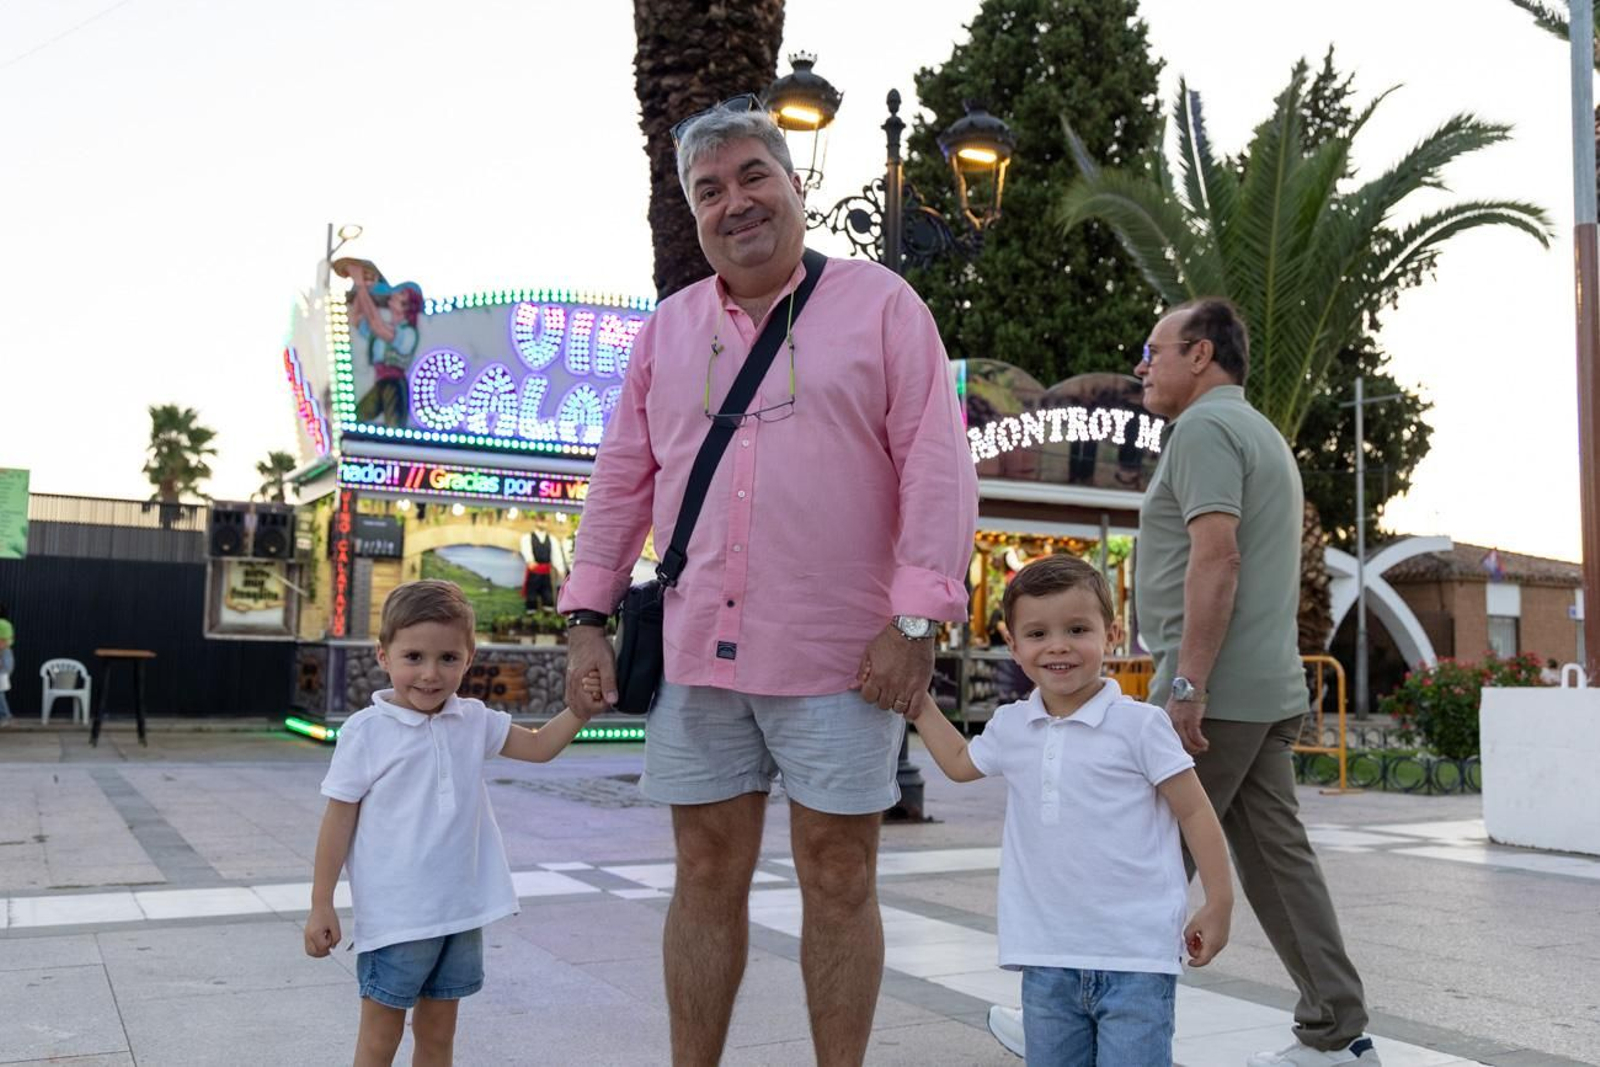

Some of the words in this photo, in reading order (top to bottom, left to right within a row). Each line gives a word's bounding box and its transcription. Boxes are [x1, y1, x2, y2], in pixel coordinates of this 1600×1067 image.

[410, 350, 621, 445] CALA
[967, 407, 1134, 464] MONTROY
[429, 468, 500, 493] Gracias
[503, 477, 536, 497] por
[538, 480, 562, 498] su
[338, 490, 352, 534] VINO
